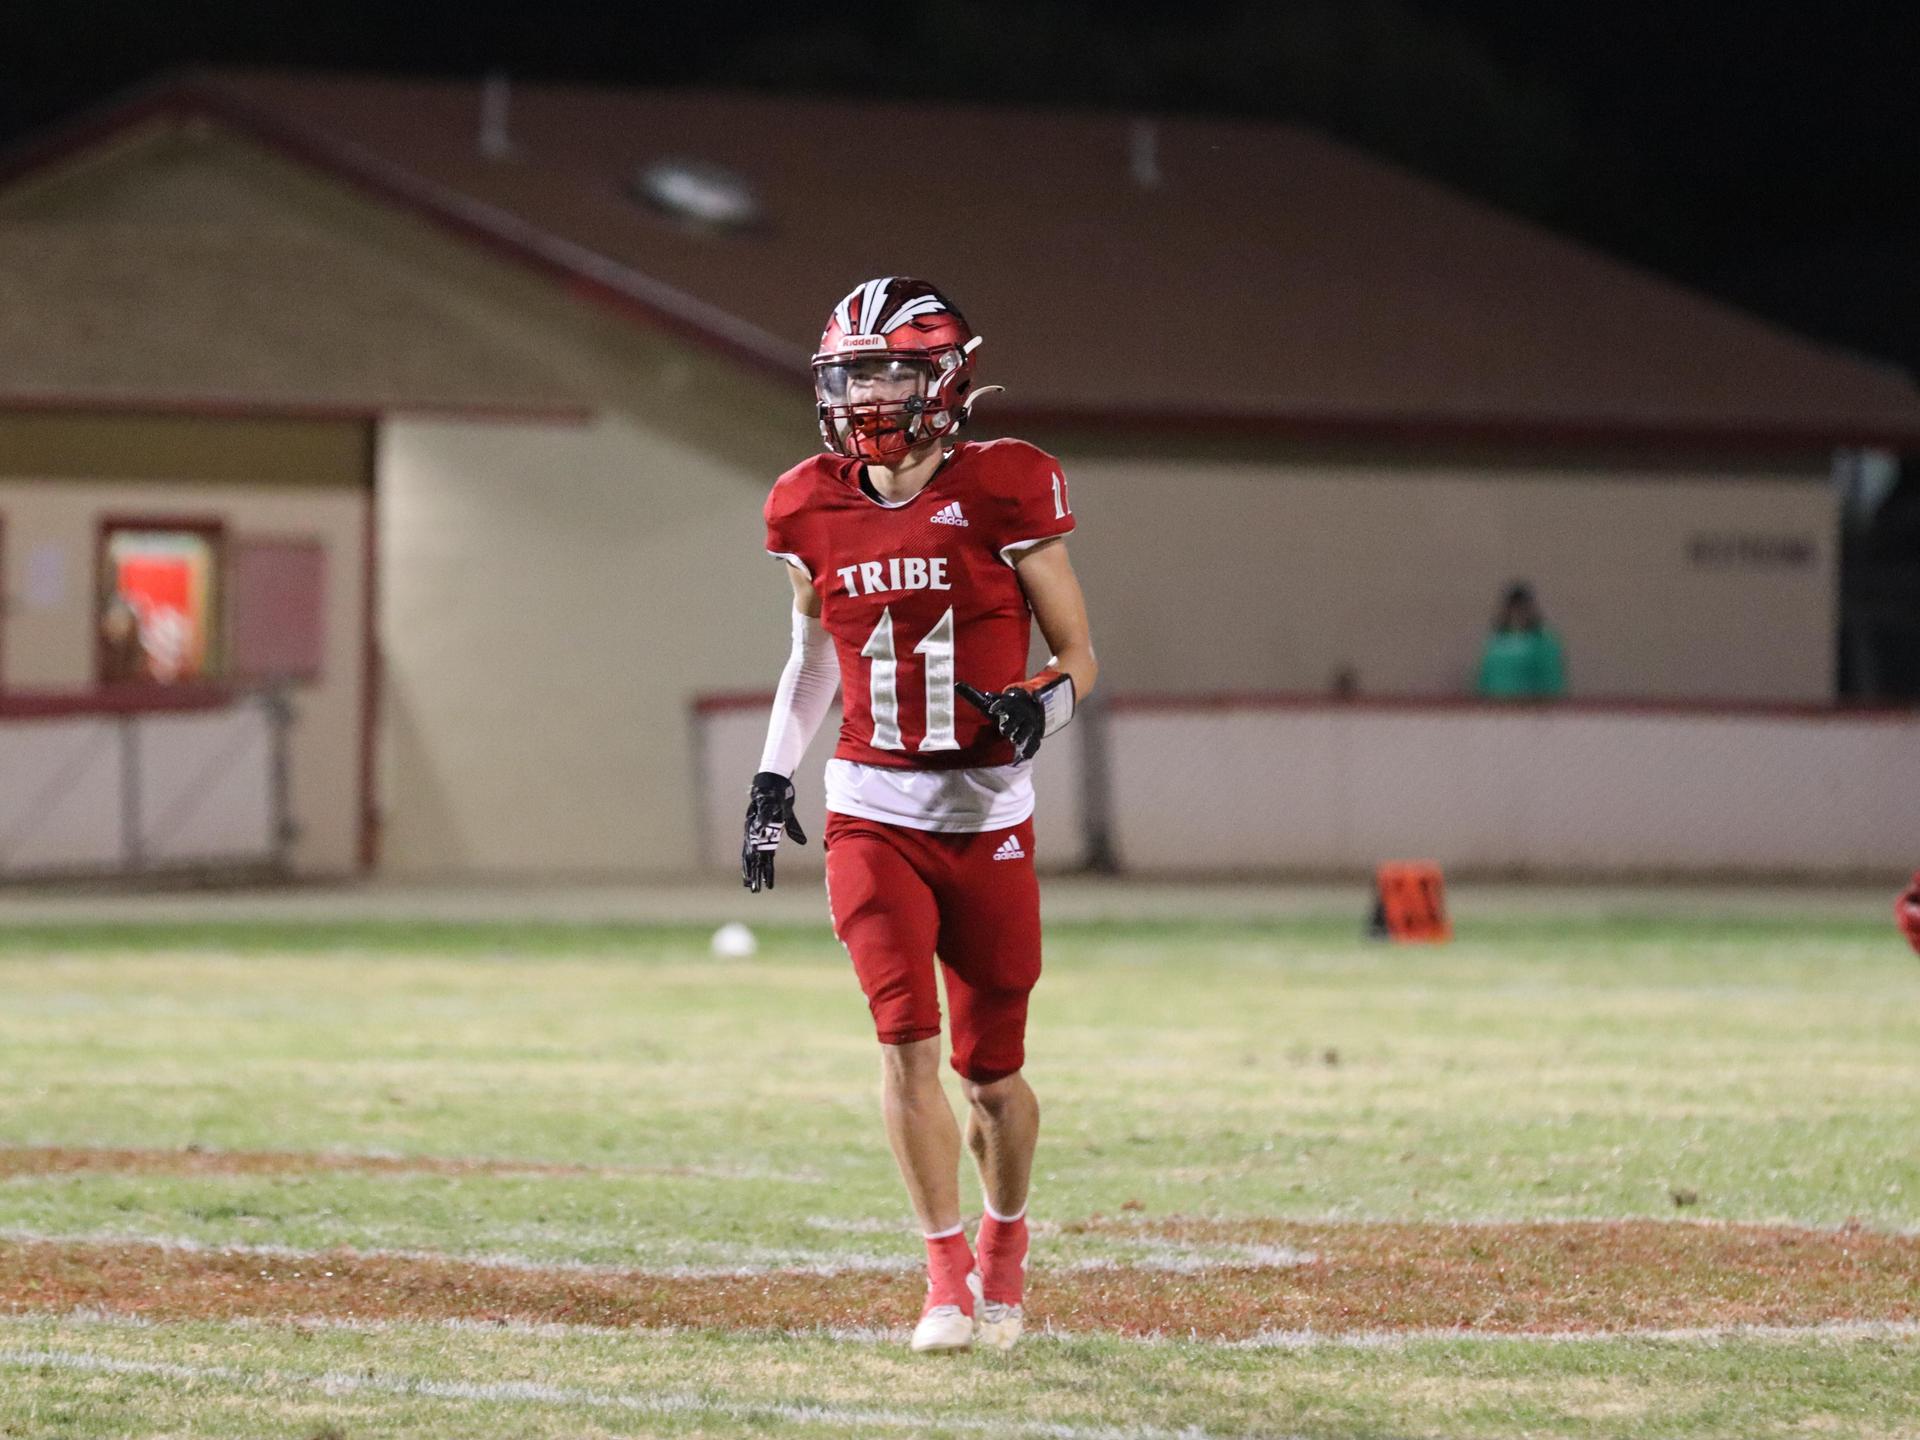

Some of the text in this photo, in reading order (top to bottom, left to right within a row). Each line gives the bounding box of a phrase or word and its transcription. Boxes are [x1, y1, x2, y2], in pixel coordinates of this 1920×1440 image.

[843, 337, 879, 346] Riddell
[930, 515, 969, 527] adidas
[837, 557, 952, 598] TRIBE
[861, 604, 960, 751] 11
[992, 850, 1025, 861] adidas
